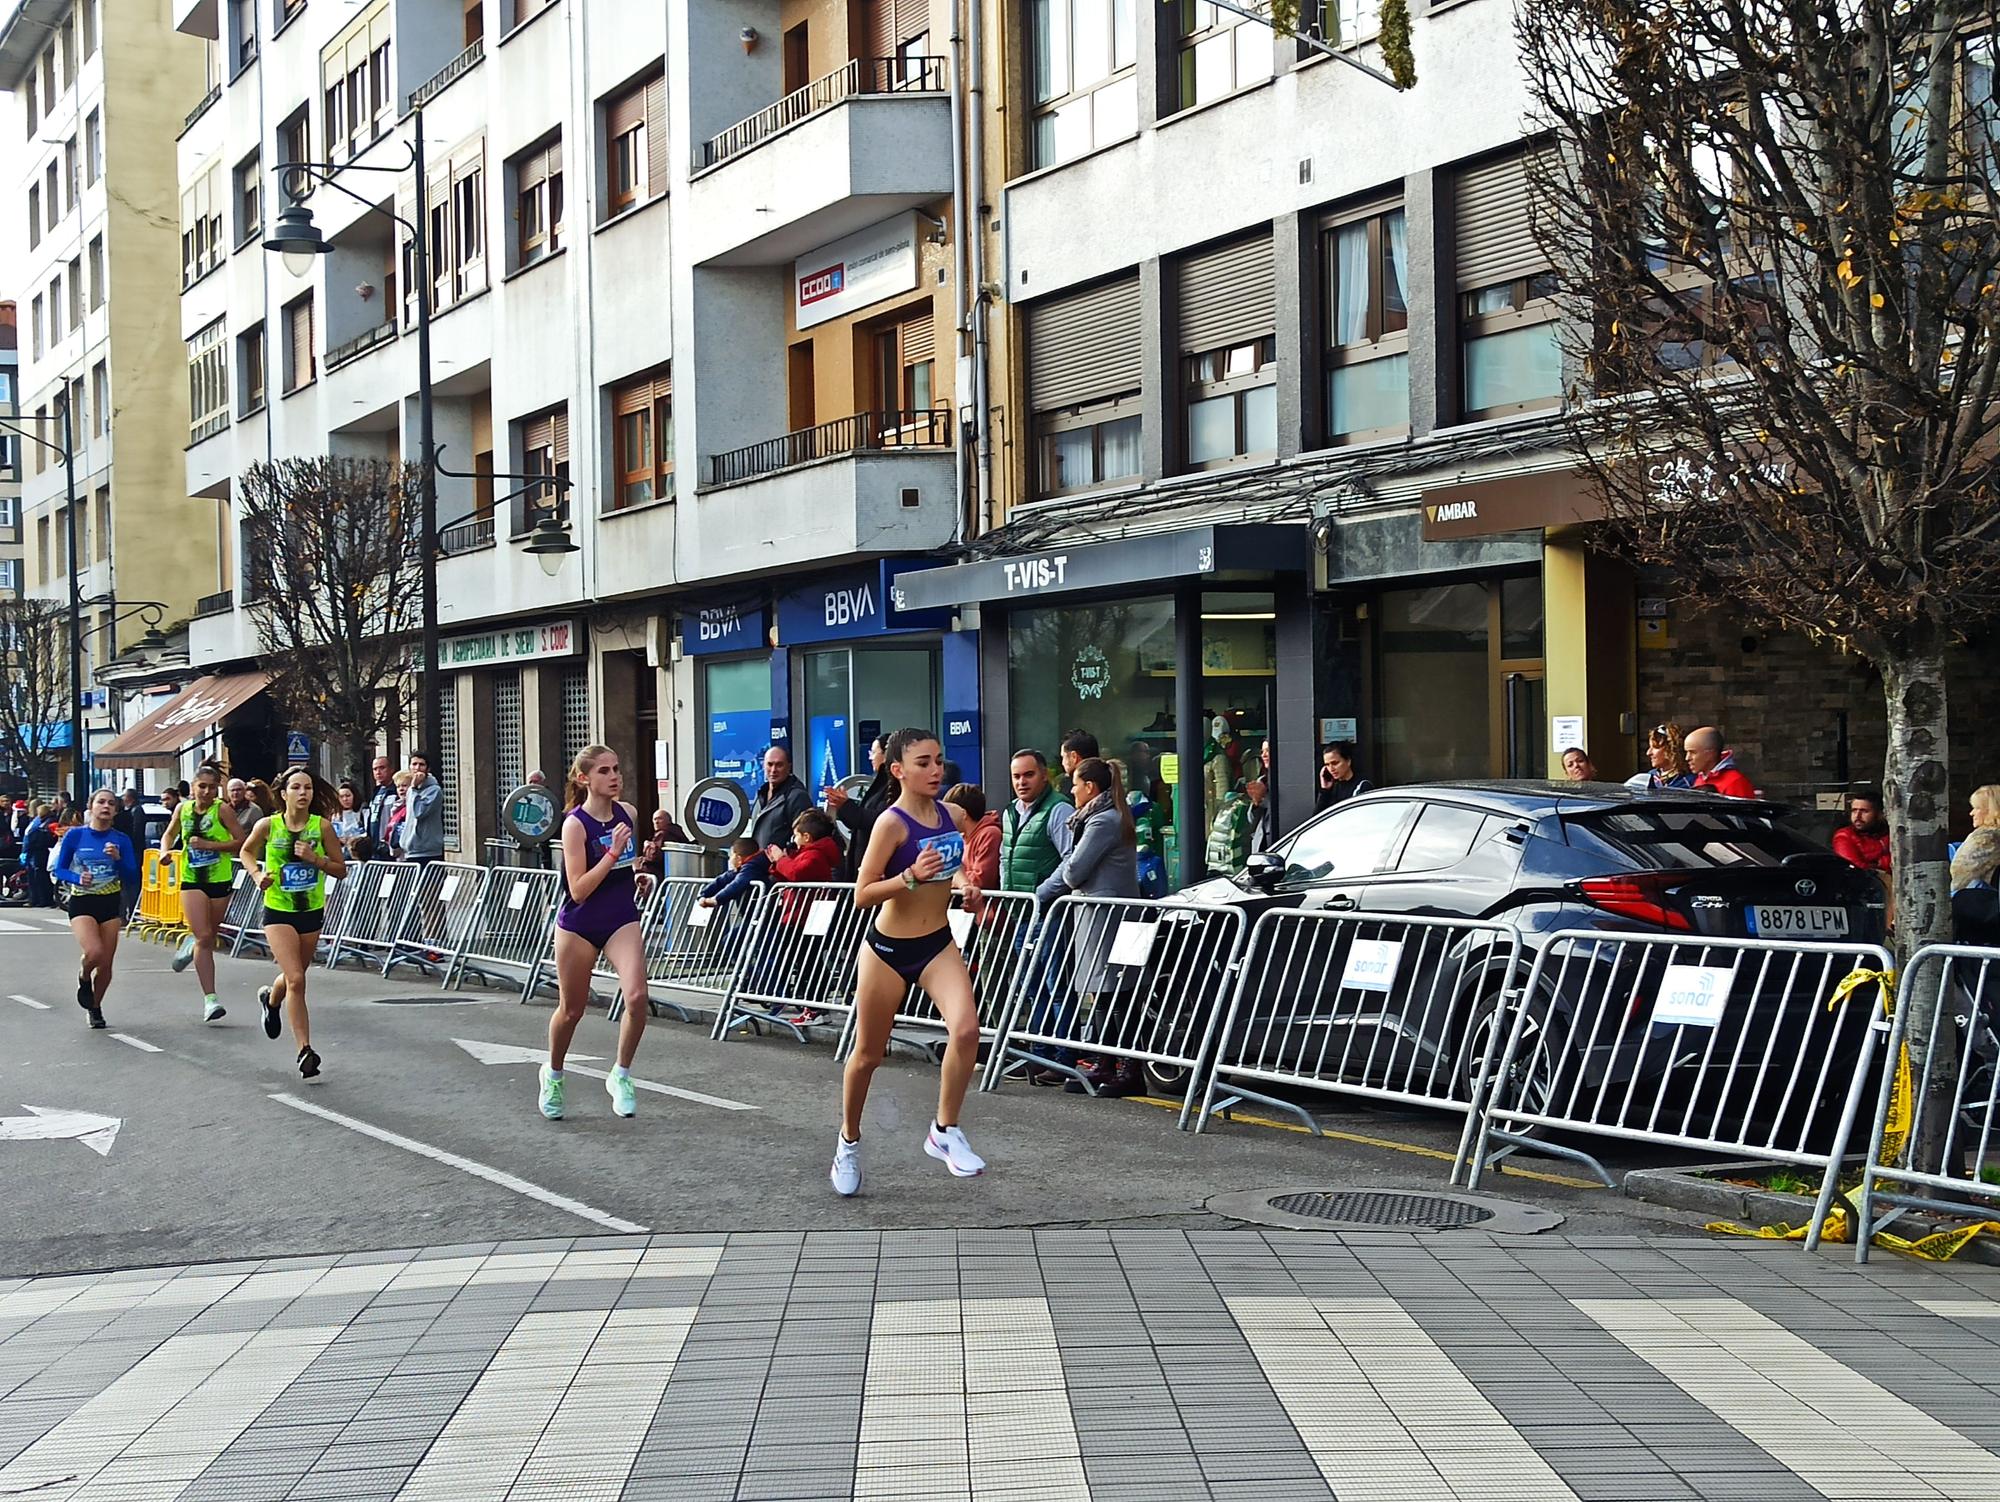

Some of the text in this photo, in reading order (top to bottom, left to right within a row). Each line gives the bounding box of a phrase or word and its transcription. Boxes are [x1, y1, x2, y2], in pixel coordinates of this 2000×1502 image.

[802, 273, 831, 300] CCOO
[1437, 500, 1477, 523] AMBAR
[1004, 556, 1067, 591] T-VIS-T
[825, 583, 875, 626] BBVA
[700, 604, 741, 641] BBVA
[501, 633, 510, 657] DE
[950, 720, 971, 735] BBVA
[283, 868, 315, 881] 1499
[1760, 909, 1845, 931] 8878 LPM
[1668, 991, 1715, 1007] sonar
